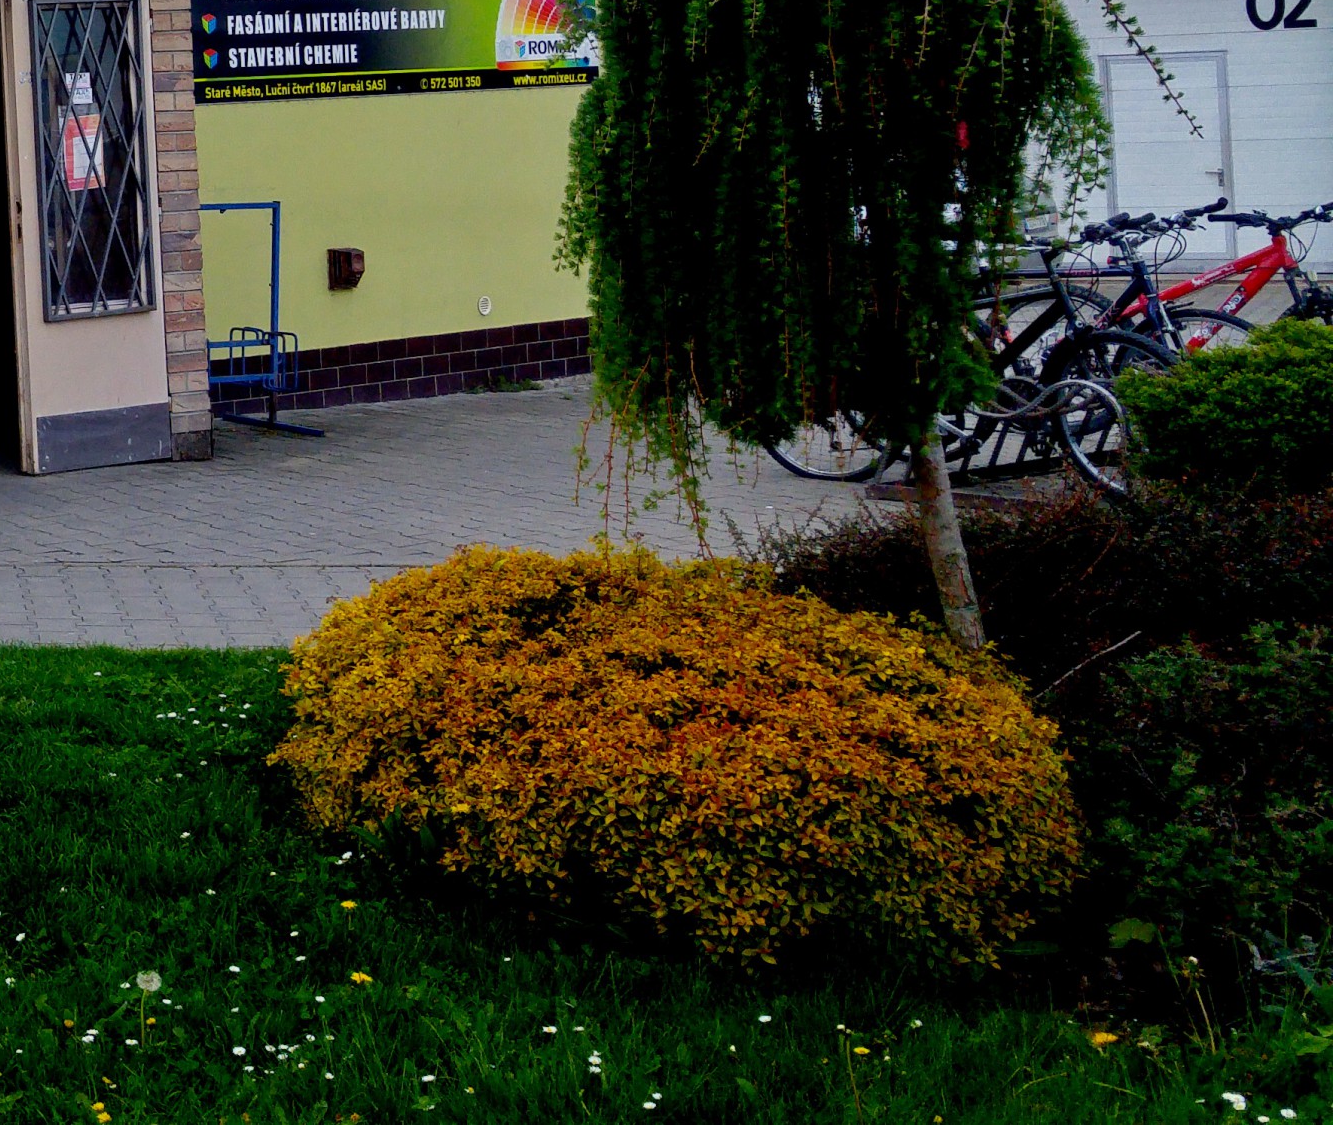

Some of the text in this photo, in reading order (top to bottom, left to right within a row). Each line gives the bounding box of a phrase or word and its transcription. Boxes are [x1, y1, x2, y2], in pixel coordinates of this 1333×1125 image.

[227, 9, 446, 35] FASÁDNÍ A INTERIÉROVÉ BARVY
[228, 43, 358, 69] STAVEBNÍ CHEMIE
[205, 86, 231, 99] Staré
[233, 85, 264, 98] Město,
[265, 83, 291, 96] Luční
[316, 81, 337, 94] 1867
[338, 80, 364, 93] (areál
[365, 79, 387, 91] SAS)
[430, 77, 447, 89] 572
[448, 77, 464, 88] 501
[465, 76, 481, 88] 350
[513, 72, 587, 86] www.romixeu.cz
